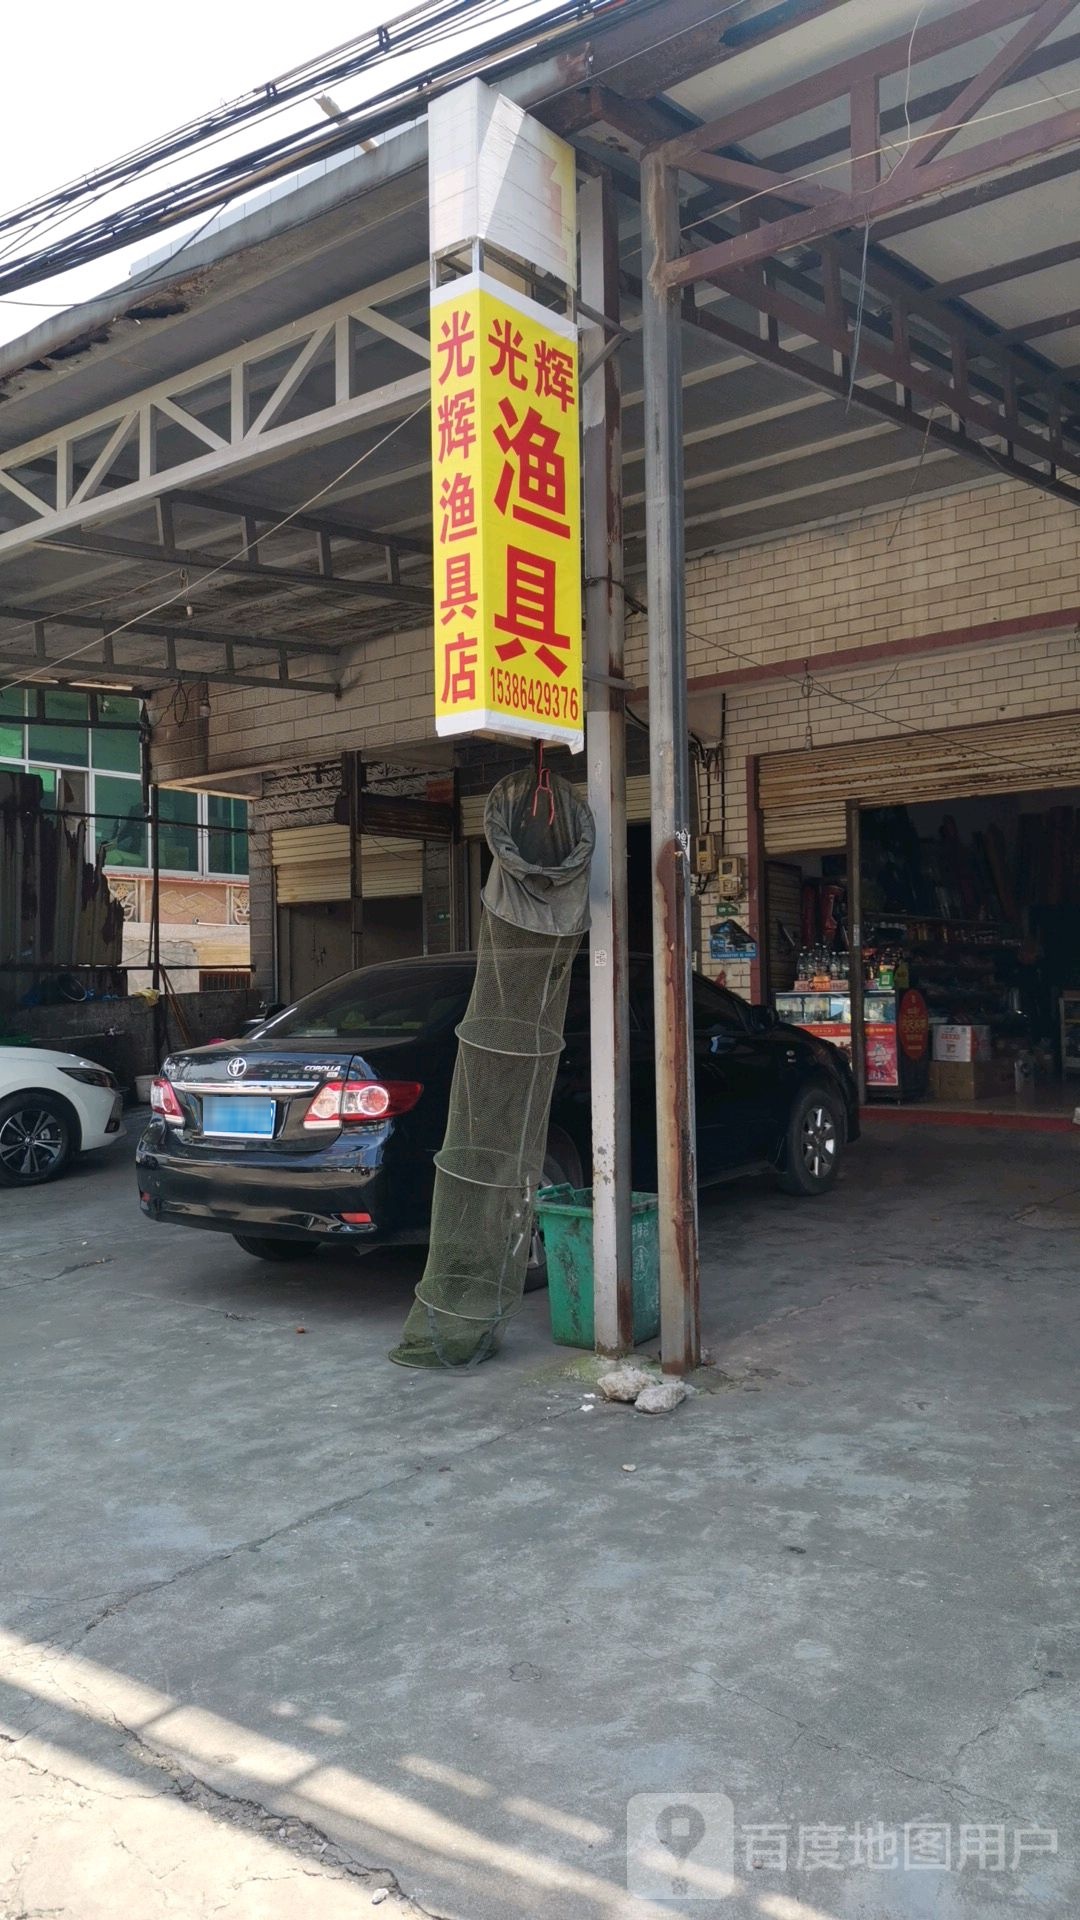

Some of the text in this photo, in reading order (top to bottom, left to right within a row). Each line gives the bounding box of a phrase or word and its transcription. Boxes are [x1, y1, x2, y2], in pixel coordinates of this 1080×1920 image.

[488, 318, 575, 413] 光辉
[437, 310, 478, 704] 光辉渔具店
[493, 397, 571, 678] 渔具
[490, 666, 578, 721] 15386429376
